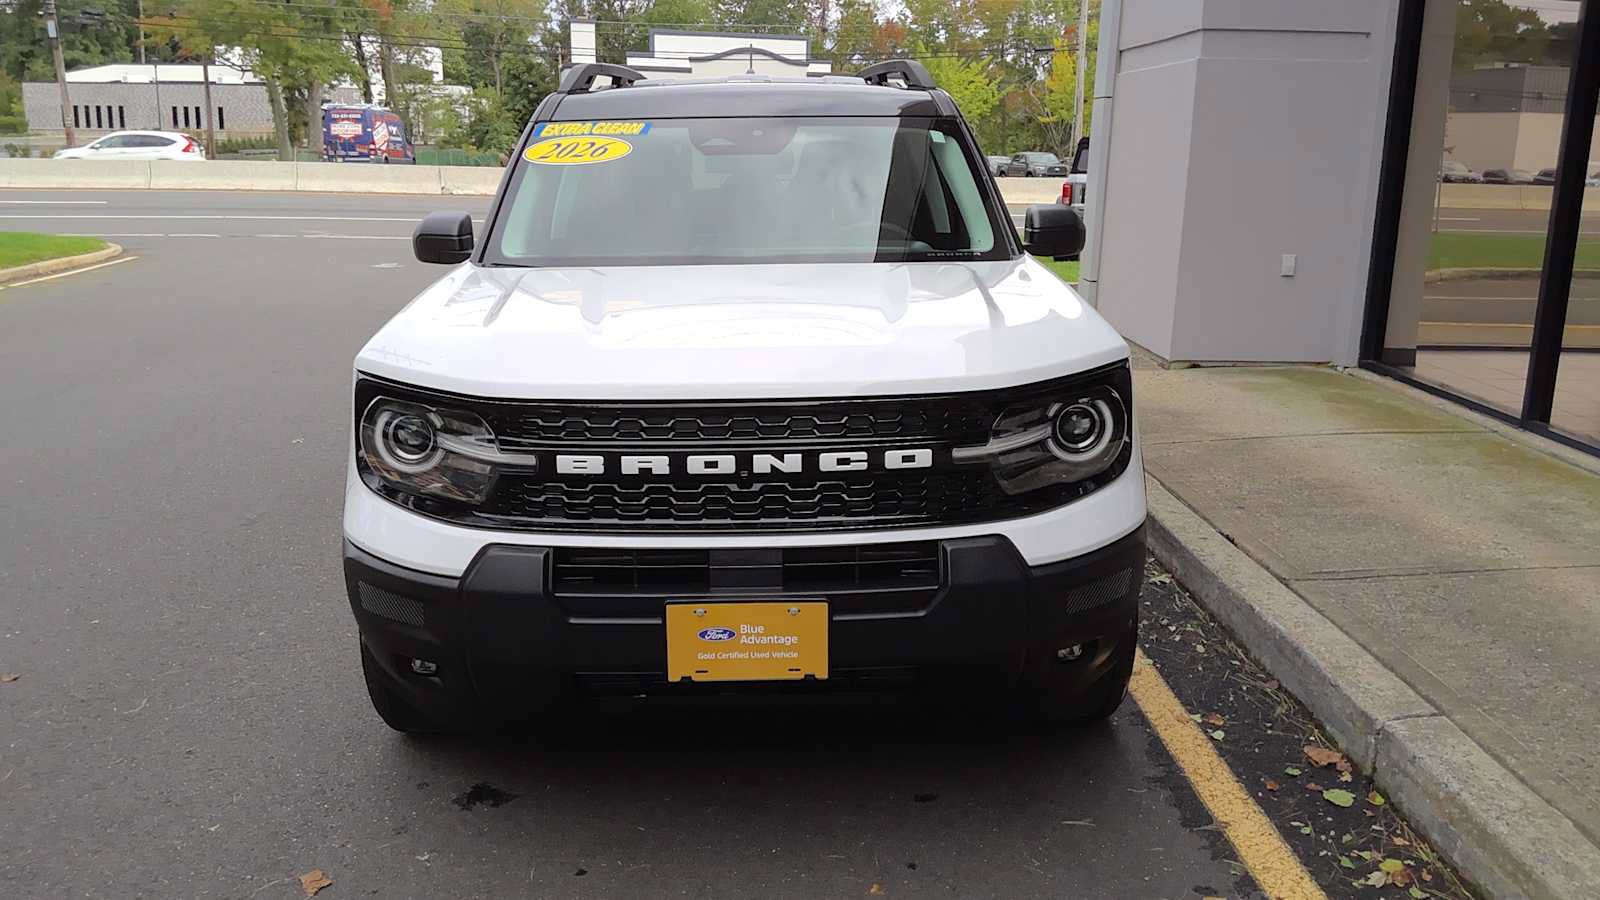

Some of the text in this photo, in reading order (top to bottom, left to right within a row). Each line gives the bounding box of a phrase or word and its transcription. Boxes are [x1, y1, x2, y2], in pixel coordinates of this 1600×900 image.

[541, 122, 645, 137] EXTRA CLEAN
[539, 142, 616, 159] 2026
[556, 449, 932, 474] BRONCO
[703, 628, 731, 641] Ford
[740, 624, 765, 634] Blue
[740, 635, 798, 646] Advantage
[697, 650, 799, 660] Gold Certified Used Vehicle
